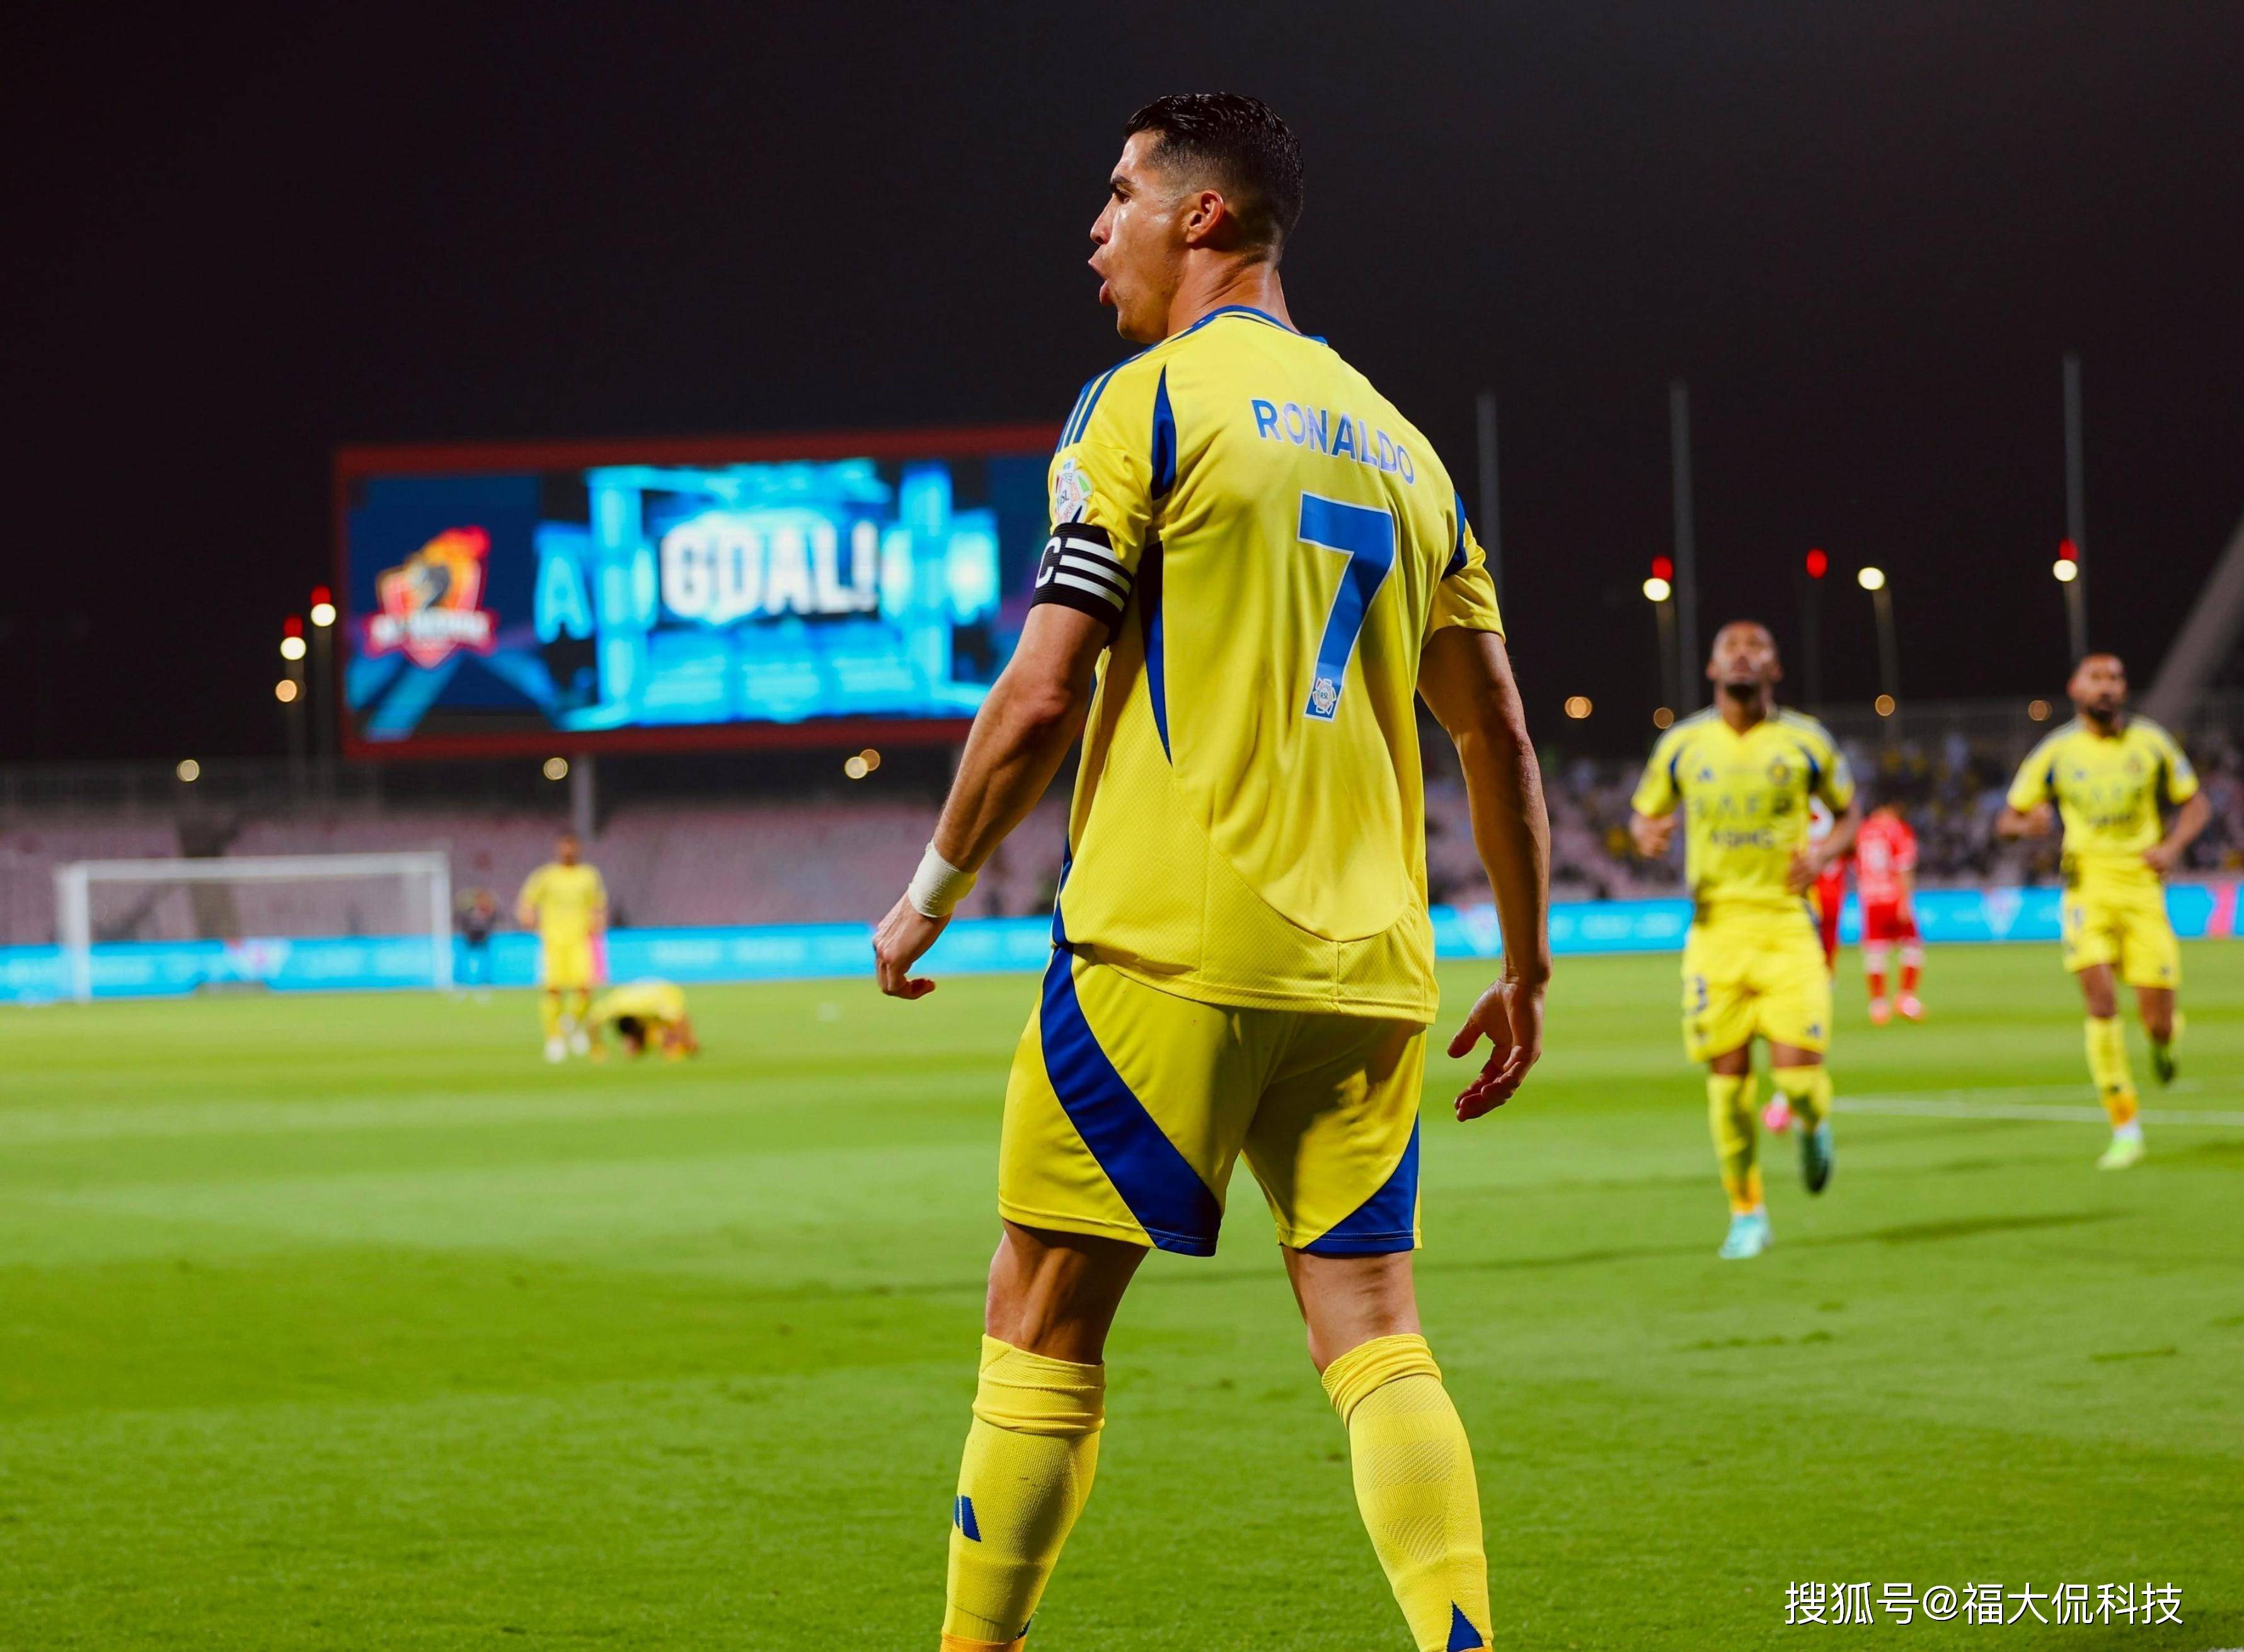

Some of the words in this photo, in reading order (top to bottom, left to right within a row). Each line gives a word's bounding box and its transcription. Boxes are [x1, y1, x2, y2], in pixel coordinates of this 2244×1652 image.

[1250, 398, 1415, 485] RONALDO
[661, 520, 879, 621] GOAL!
[1035, 536, 1062, 588] C
[1297, 490, 1396, 723] 7
